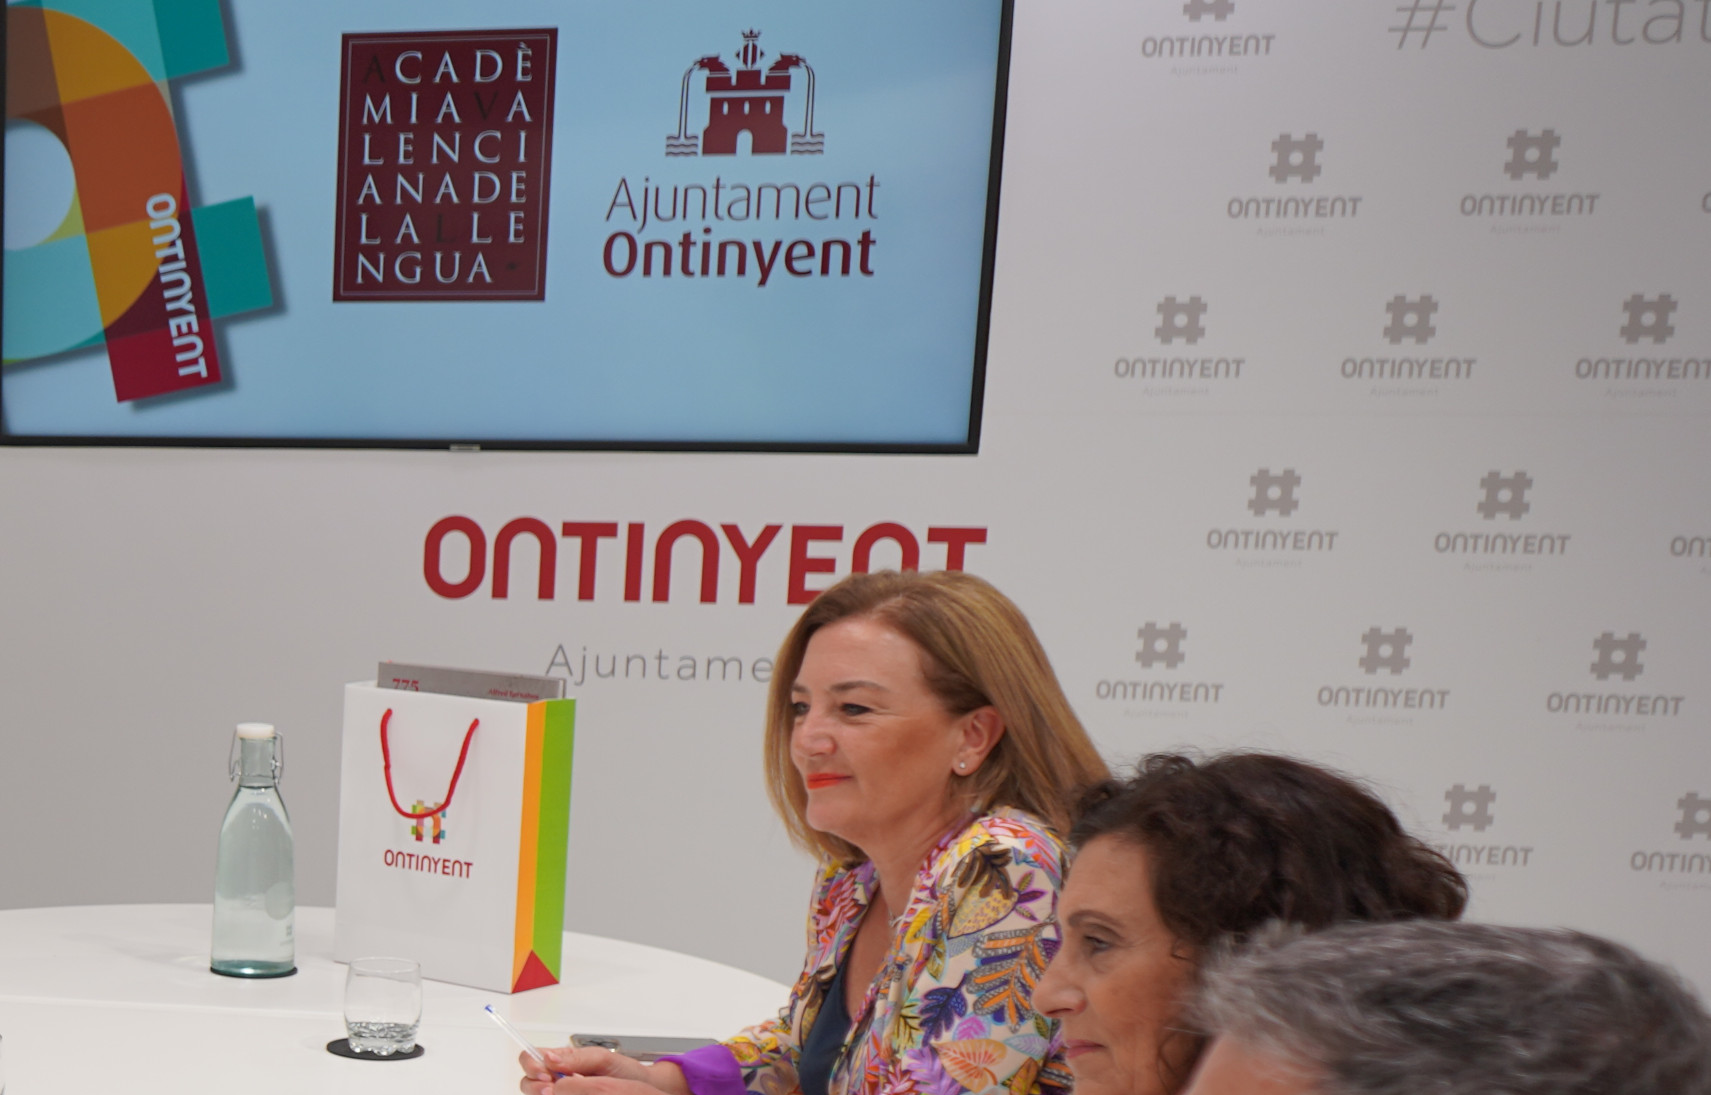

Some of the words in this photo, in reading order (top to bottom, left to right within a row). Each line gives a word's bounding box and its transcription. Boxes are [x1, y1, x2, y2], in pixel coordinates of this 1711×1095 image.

[1141, 33, 1276, 58] ONTINYENT
[605, 173, 881, 234] Ajuntament
[1227, 195, 1363, 219] ONTINYENT
[1460, 192, 1601, 216] ONTINYENT
[603, 226, 876, 288] Ontinyent
[145, 192, 209, 379] ONTINYENT
[1114, 357, 1246, 380] ONTINYENT
[1340, 357, 1478, 380] ONTINYENT
[1206, 528, 1339, 552] ONTINYENT
[1434, 532, 1572, 556] ONTINYENT
[545, 643, 773, 686] Ajuntame
[1095, 679, 1224, 704] ONTINYENT
[1317, 686, 1451, 710] ONTINYENT
[1546, 692, 1685, 717] ONTINYENT
[383, 848, 473, 879] ONTINYENT
